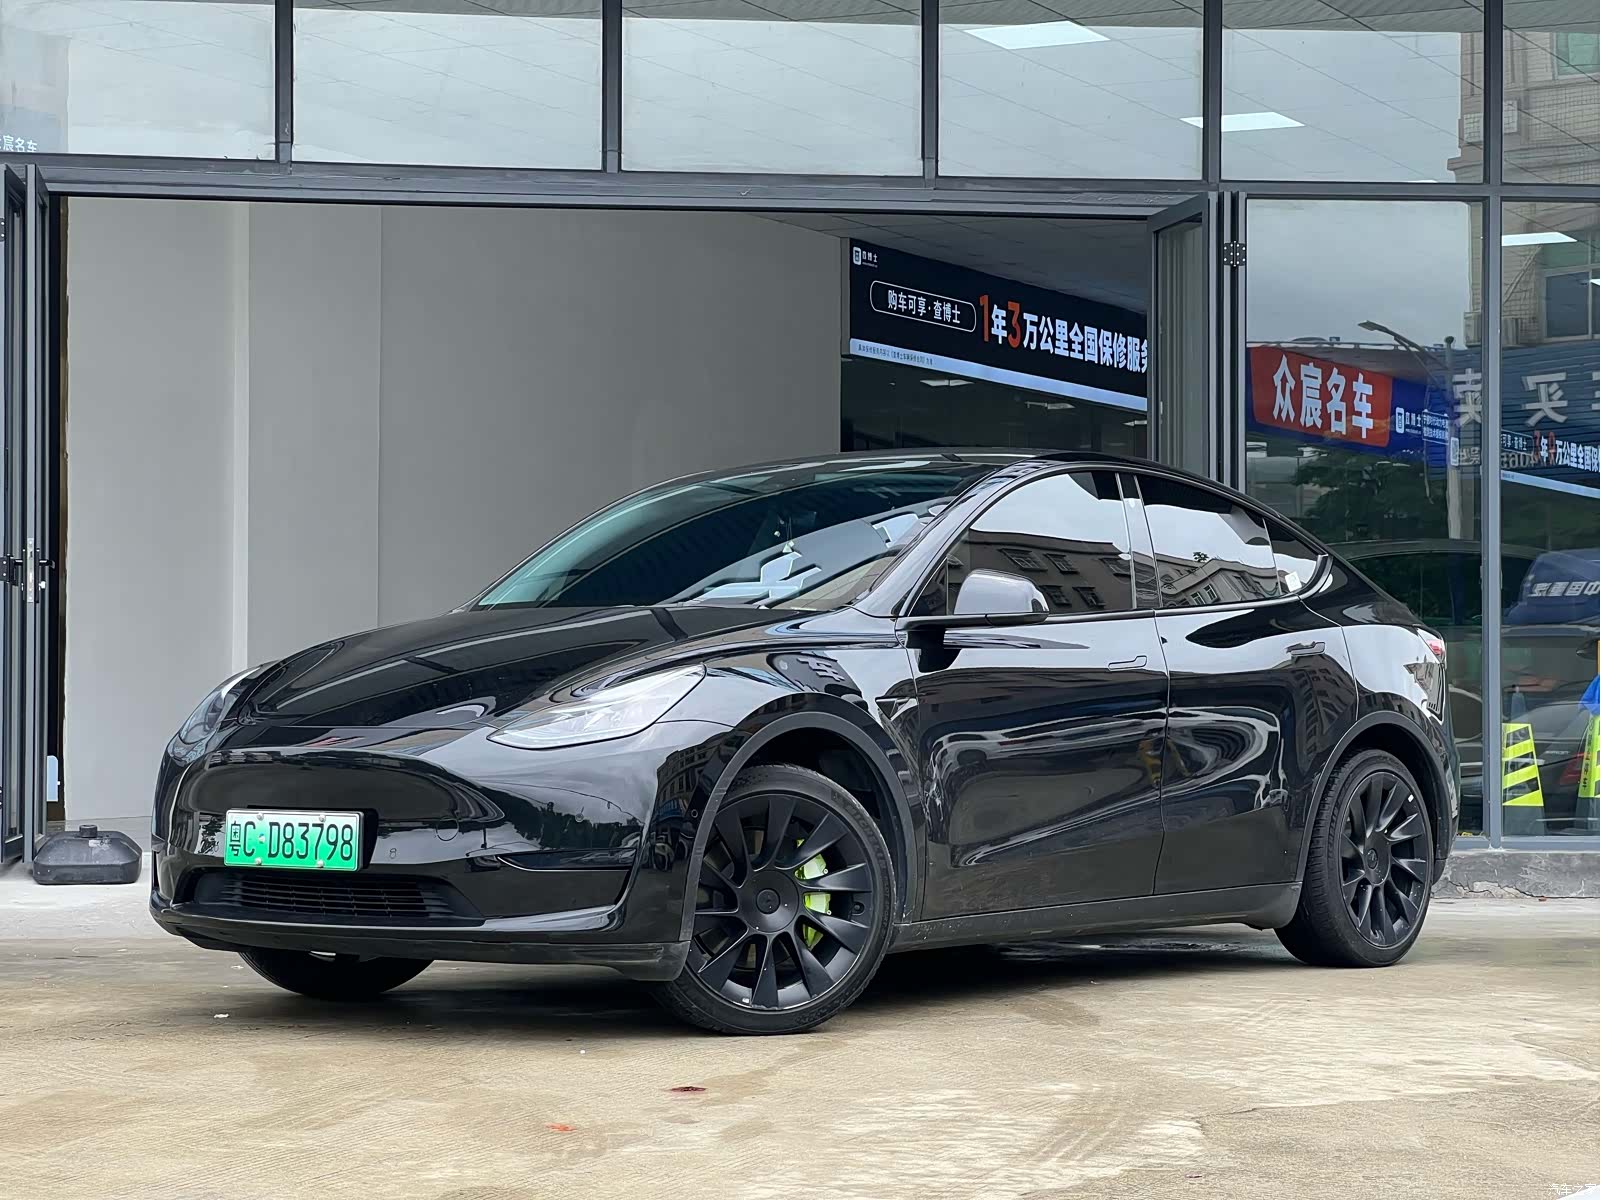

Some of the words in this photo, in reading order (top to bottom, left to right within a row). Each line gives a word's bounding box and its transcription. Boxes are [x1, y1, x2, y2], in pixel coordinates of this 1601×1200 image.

[0, 135, 38, 153] 宸名车
[888, 289, 961, 324] 购车可享·查博士
[1273, 354, 1374, 439] 众宸名车
[268, 821, 354, 861] D83798
